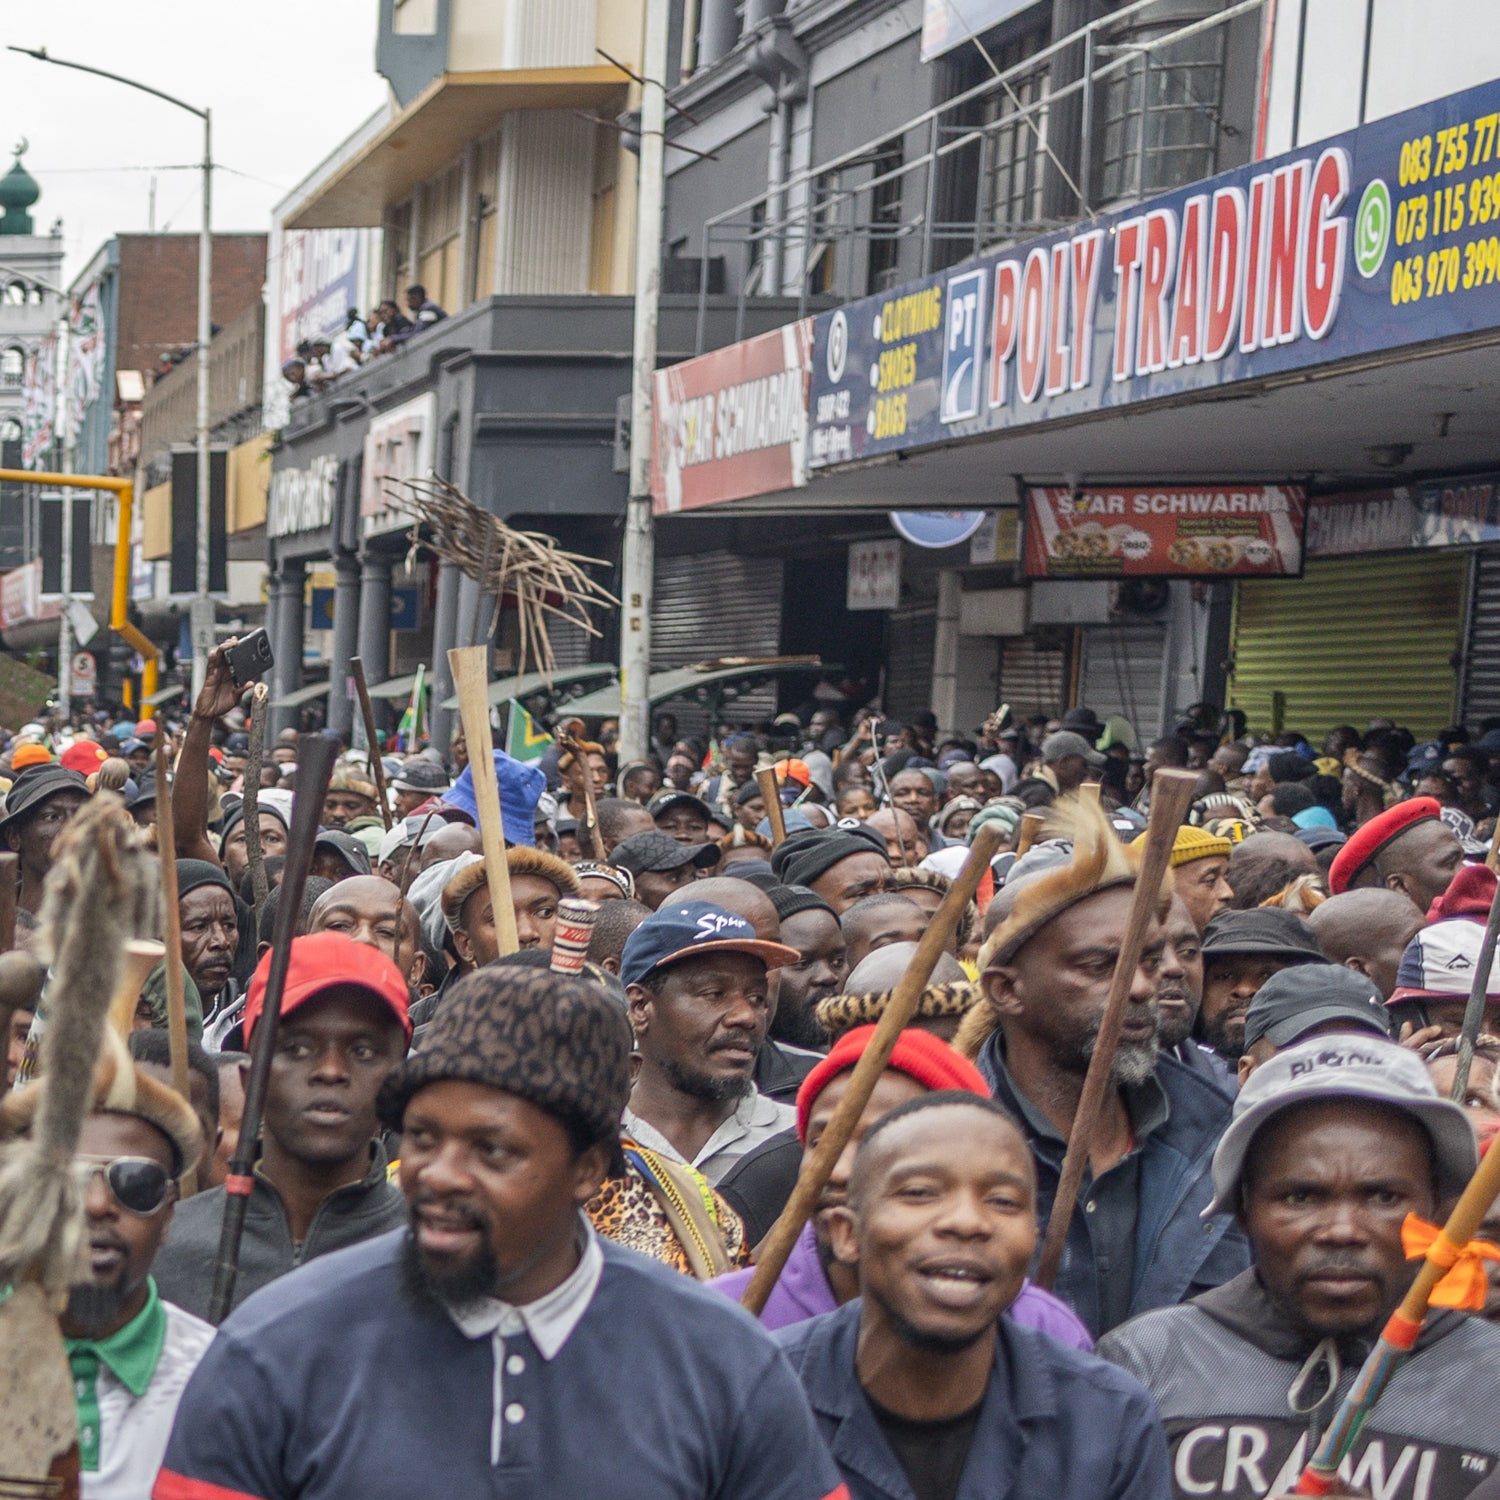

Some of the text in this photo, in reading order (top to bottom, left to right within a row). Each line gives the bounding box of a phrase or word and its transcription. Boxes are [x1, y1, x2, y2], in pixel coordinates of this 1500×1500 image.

[1399, 134, 1431, 187] 083
[1434, 123, 1469, 177] 755
[1395, 194, 1428, 246] 073
[1432, 183, 1466, 236] 115
[990, 146, 1351, 409] POLY TRADING
[1391, 236, 1500, 306] 063 970 399
[951, 293, 977, 351] PT
